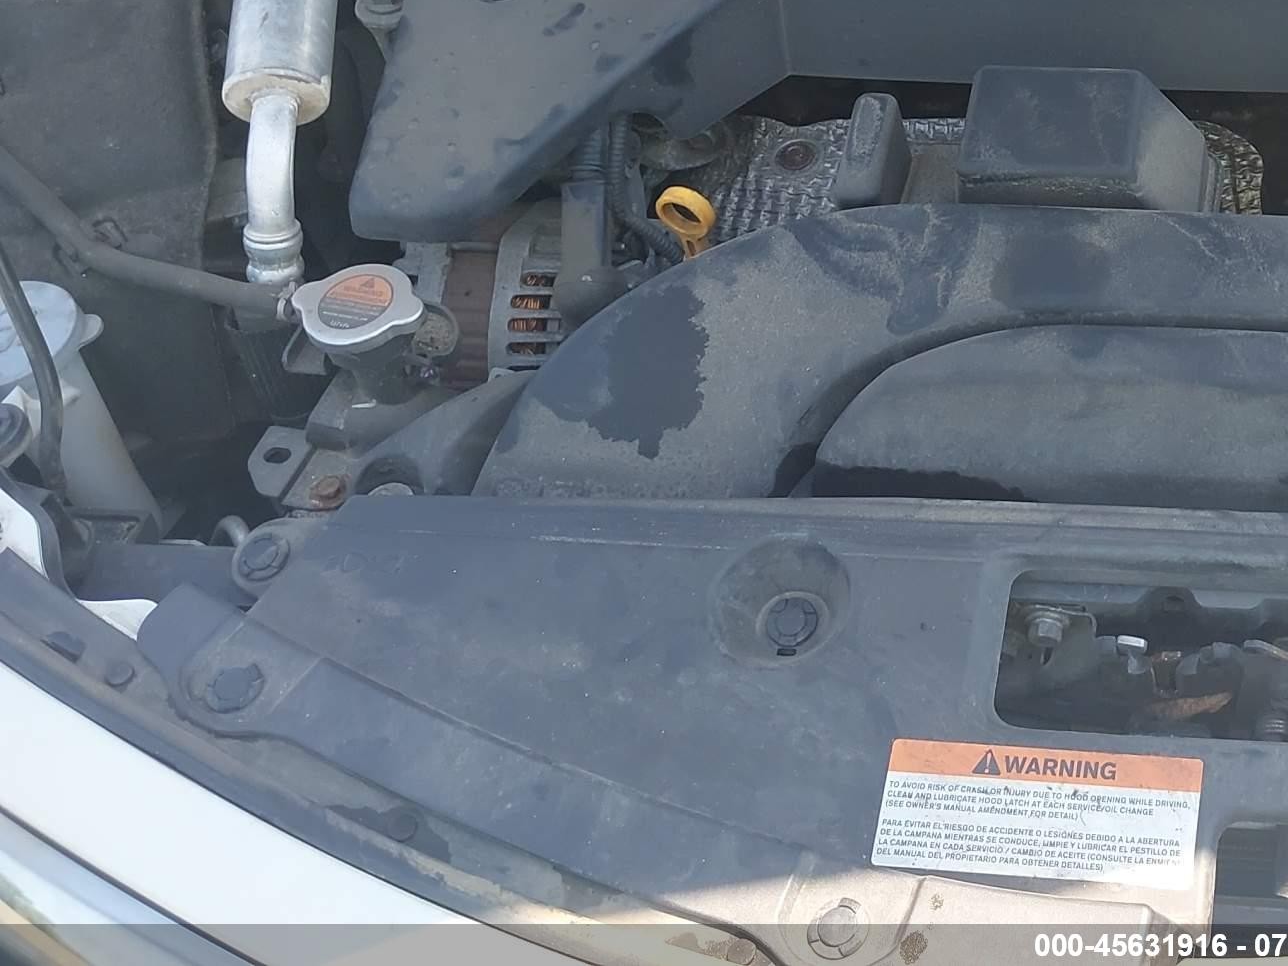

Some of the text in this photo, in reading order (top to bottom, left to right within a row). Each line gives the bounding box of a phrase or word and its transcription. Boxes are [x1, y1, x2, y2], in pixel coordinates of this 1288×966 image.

[1004, 755, 1117, 780] WARNING
[887, 790, 1154, 816] CLEAN AND LUBRICATE HOOD LATCH AT EACH SERVICE/OIL CHANGE
[890, 780, 900, 788] TO
[901, 781, 926, 790] AVOID
[927, 783, 946, 792] RISK
[948, 784, 960, 792] OF
[990, 787, 1002, 795] OR
[1003, 787, 1031, 797] INJURY
[1032, 790, 1049, 799] DUE
[1052, 792, 1062, 800] TO
[1064, 792, 1089, 802] HOOD
[1090, 795, 1127, 804] OPENING
[1129, 797, 1153, 806] WHILE
[885, 799, 904, 808] (SEE
[906, 801, 942, 811] OWNER'S
[943, 804, 976, 814] MANUAL
[1048, 811, 1079, 821] DETAIL)
[880, 828, 1181, 857] DE LA CAMPANA MIENTRAS SE CONDUCE, LIMPIE Y LUBRICAR EL PESTILLO DE
[882, 818, 902, 827] PARA
[933, 822, 943, 830] EL
[944, 823, 975, 833] RIESGO
[976, 825, 987, 833] DE
[989, 826, 1034, 837] ACCIDENTE
[1043, 830, 1084, 840] LESIONES
[1085, 833, 1117, 843] DEBIDO
[1117, 835, 1124, 843] A
[1125, 836, 1135, 844] LA
[1137, 837, 1180, 847] ABERTURA
[876, 847, 1104, 872] DEL MANUAL DEL PROPIETARIO PARA OBTENER DETALLES)
[878, 838, 888, 846] LA
[889, 839, 928, 849] CAMPANA
[929, 842, 941, 850] EN
[942, 842, 964, 852] CADA
[965, 844, 1004, 854] SERVICIO
[1011, 847, 1043, 857] CAMBIO
[1044, 850, 1056, 858] DE
[1057, 850, 1086, 860] ACEITE
[1087, 852, 1134, 864] (CONSULTE
[1134, 856, 1144, 865] LA
